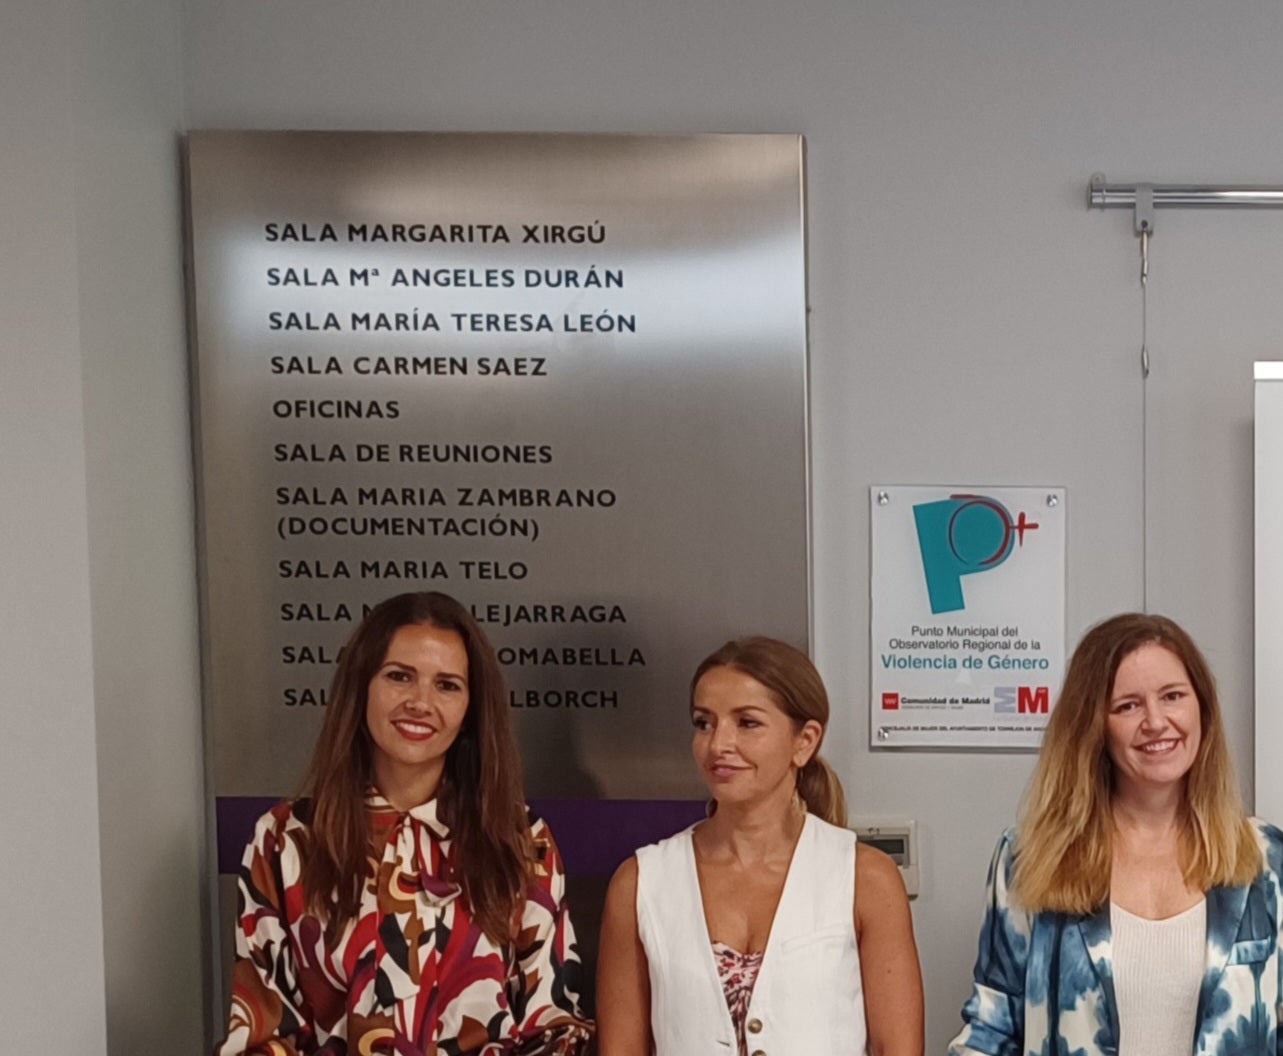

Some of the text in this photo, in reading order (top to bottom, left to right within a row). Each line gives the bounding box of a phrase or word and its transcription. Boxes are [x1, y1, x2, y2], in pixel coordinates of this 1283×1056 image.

[265, 220, 606, 244] SALA MARGARITA XIRGÚ
[267, 265, 624, 289] SALA Mª ANGELES DURÁN
[268, 307, 636, 333] SALA MARÍA TERESA LEÓN
[270, 355, 547, 376] SALA CARMEN SAEZ
[272, 399, 400, 419] OFICINAS
[274, 443, 553, 464] SALA DE REUNIONES
[276, 486, 617, 508] SALA MARIA ZAMBRANO
[277, 513, 539, 542] (DOCUMENTACIÓN)
[278, 559, 528, 580] SALA MARIA TELO
[280, 603, 352, 622] SALA
[471, 604, 627, 627] LEJARRAGA
[911, 625, 1019, 639] Punto Municipal del
[889, 638, 1041, 653] Observatorio Regional de la
[497, 647, 646, 667] OMABELLA
[881, 653, 1049, 670] Violencia de Género
[284, 688, 618, 709] SAL LBORCH
[900, 696, 991, 706] Comunidad de Madrid
